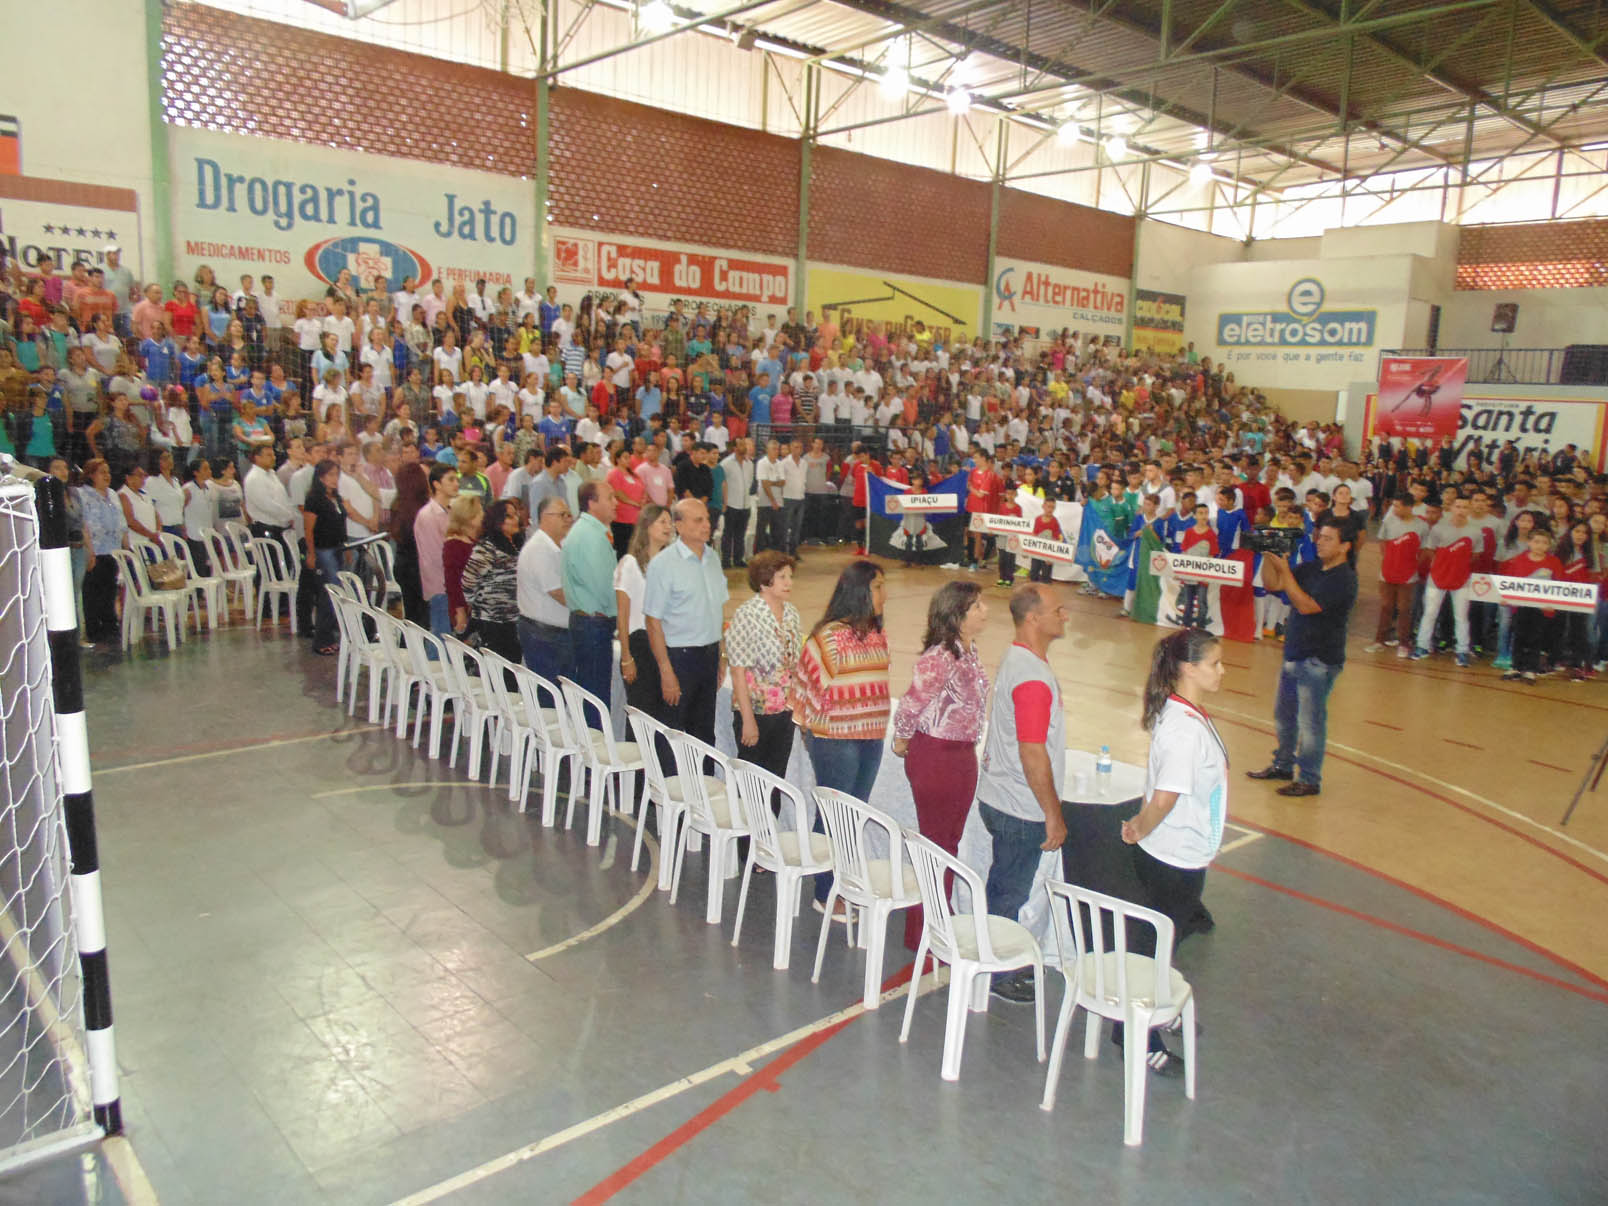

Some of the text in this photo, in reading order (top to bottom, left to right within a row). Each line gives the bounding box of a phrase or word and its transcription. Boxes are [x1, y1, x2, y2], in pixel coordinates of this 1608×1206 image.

[194, 157, 517, 246] Drogaria Jato
[186, 240, 291, 264] MEDICAMENTOS
[600, 244, 786, 303] Casa do Campo
[1021, 271, 1125, 313] Alternativa
[1223, 314, 1368, 343] eletrosom
[1236, 352, 1252, 363] por
[1282, 352, 1300, 363] que
[1316, 351, 1345, 364] gente
[1348, 351, 1364, 362] faz
[1458, 403, 1558, 434] Santa
[910, 496, 938, 505] IPIAÇU
[1022, 538, 1070, 554] CENTRALINA
[1499, 580, 1541, 594] SANTA
